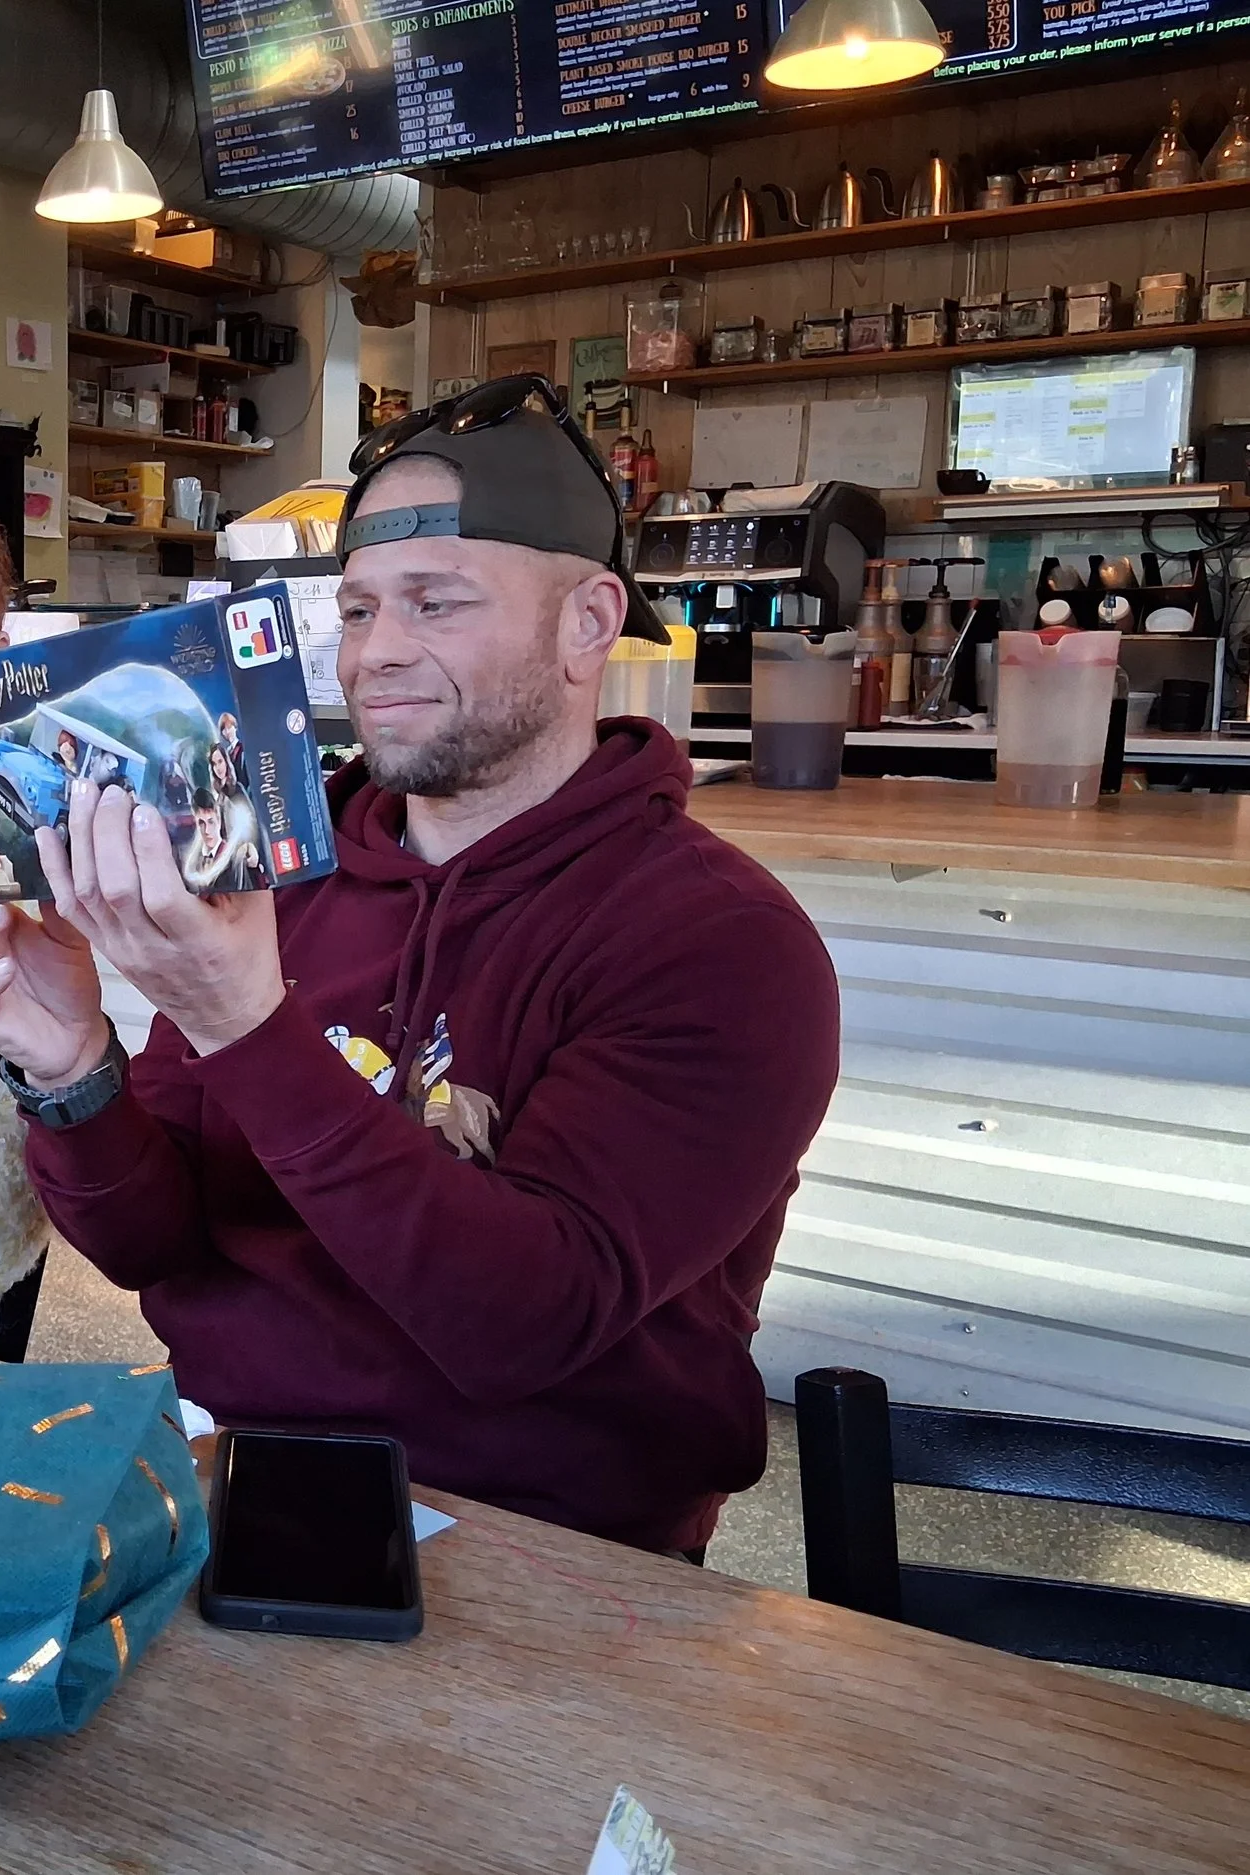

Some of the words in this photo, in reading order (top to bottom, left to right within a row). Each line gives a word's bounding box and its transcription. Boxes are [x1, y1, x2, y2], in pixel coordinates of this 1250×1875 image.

[391, 18, 418, 35] SIDES
[422, 16, 430, 28] &
[434, 0, 514, 27] ENHANCEMENTS
[555, 1, 594, 17] ULTIMATE
[987, 3, 1010, 20] 5.50
[1043, 5, 1065, 21] YOU
[1071, 1, 1096, 16] PICK
[1140, 13, 1151, 21] for
[1153, 6, 1188, 19] additional
[558, 33, 587, 50] DOUBLE
[591, 28, 621, 44] DECKER
[625, 19, 664, 36] SMASHED
[669, 12, 701, 28] BURGER
[736, 4, 747, 19] 15
[987, 19, 1010, 35] 5.75
[934, 63, 964, 77] Before
[967, 58, 1000, 75] placing
[1003, 54, 1027, 68] your
[1060, 42, 1092, 59] please
[1094, 36, 1128, 50] inform
[1131, 33, 1156, 47] your
[1159, 25, 1193, 40] server
[1196, 21, 1203, 33] if
[1207, 23, 1213, 31] a
[989, 34, 1010, 49] 3.75
[210, 60, 236, 77] PESTO
[416, 55, 434, 66] FRIES
[560, 67, 584, 83] PLANT
[589, 62, 613, 77] BASED
[616, 57, 643, 72] SMOKE
[648, 51, 674, 67] HOUSE
[678, 47, 693, 60] BBQ
[698, 42, 730, 57] BURGER
[737, 39, 748, 54] 15
[395, 72, 415, 84] SMALL
[418, 67, 439, 79] GREEN
[442, 62, 463, 75] SALAD
[397, 82, 427, 96] AVOCADO
[425, 88, 453, 102] CHICKEN
[562, 100, 591, 115] CHEESE
[595, 94, 625, 110] BURGER
[690, 83, 697, 96] 6
[742, 74, 750, 88] 9
[346, 104, 357, 118] 25
[399, 106, 425, 118] SMOKED
[428, 100, 455, 113] SALMON
[516, 113, 523, 123] 10
[350, 127, 359, 140] 16
[429, 137, 456, 150] SALMON
[517, 125, 524, 135] 10
[270, 174, 307, 187] undercooked
[411, 154, 427, 165] eggs
[428, 152, 443, 161] may
[445, 147, 472, 158] increase
[472, 143, 489, 155] your
[491, 140, 503, 150] risk
[504, 139, 512, 148] of
[514, 136, 530, 146] food
[532, 132, 552, 143] borne
[577, 122, 613, 137] especially
[614, 120, 619, 129] if
[620, 120, 636, 131] you
[637, 116, 656, 127] have
[658, 112, 684, 123] certain
[686, 106, 715, 119] medical
[717, 101, 759, 114] conditions.
[2, 659, 49, 701] Potter
[259, 751, 279, 794] Potter
[269, 795, 291, 834] Harry
[278, 840, 293, 869] LEGO
